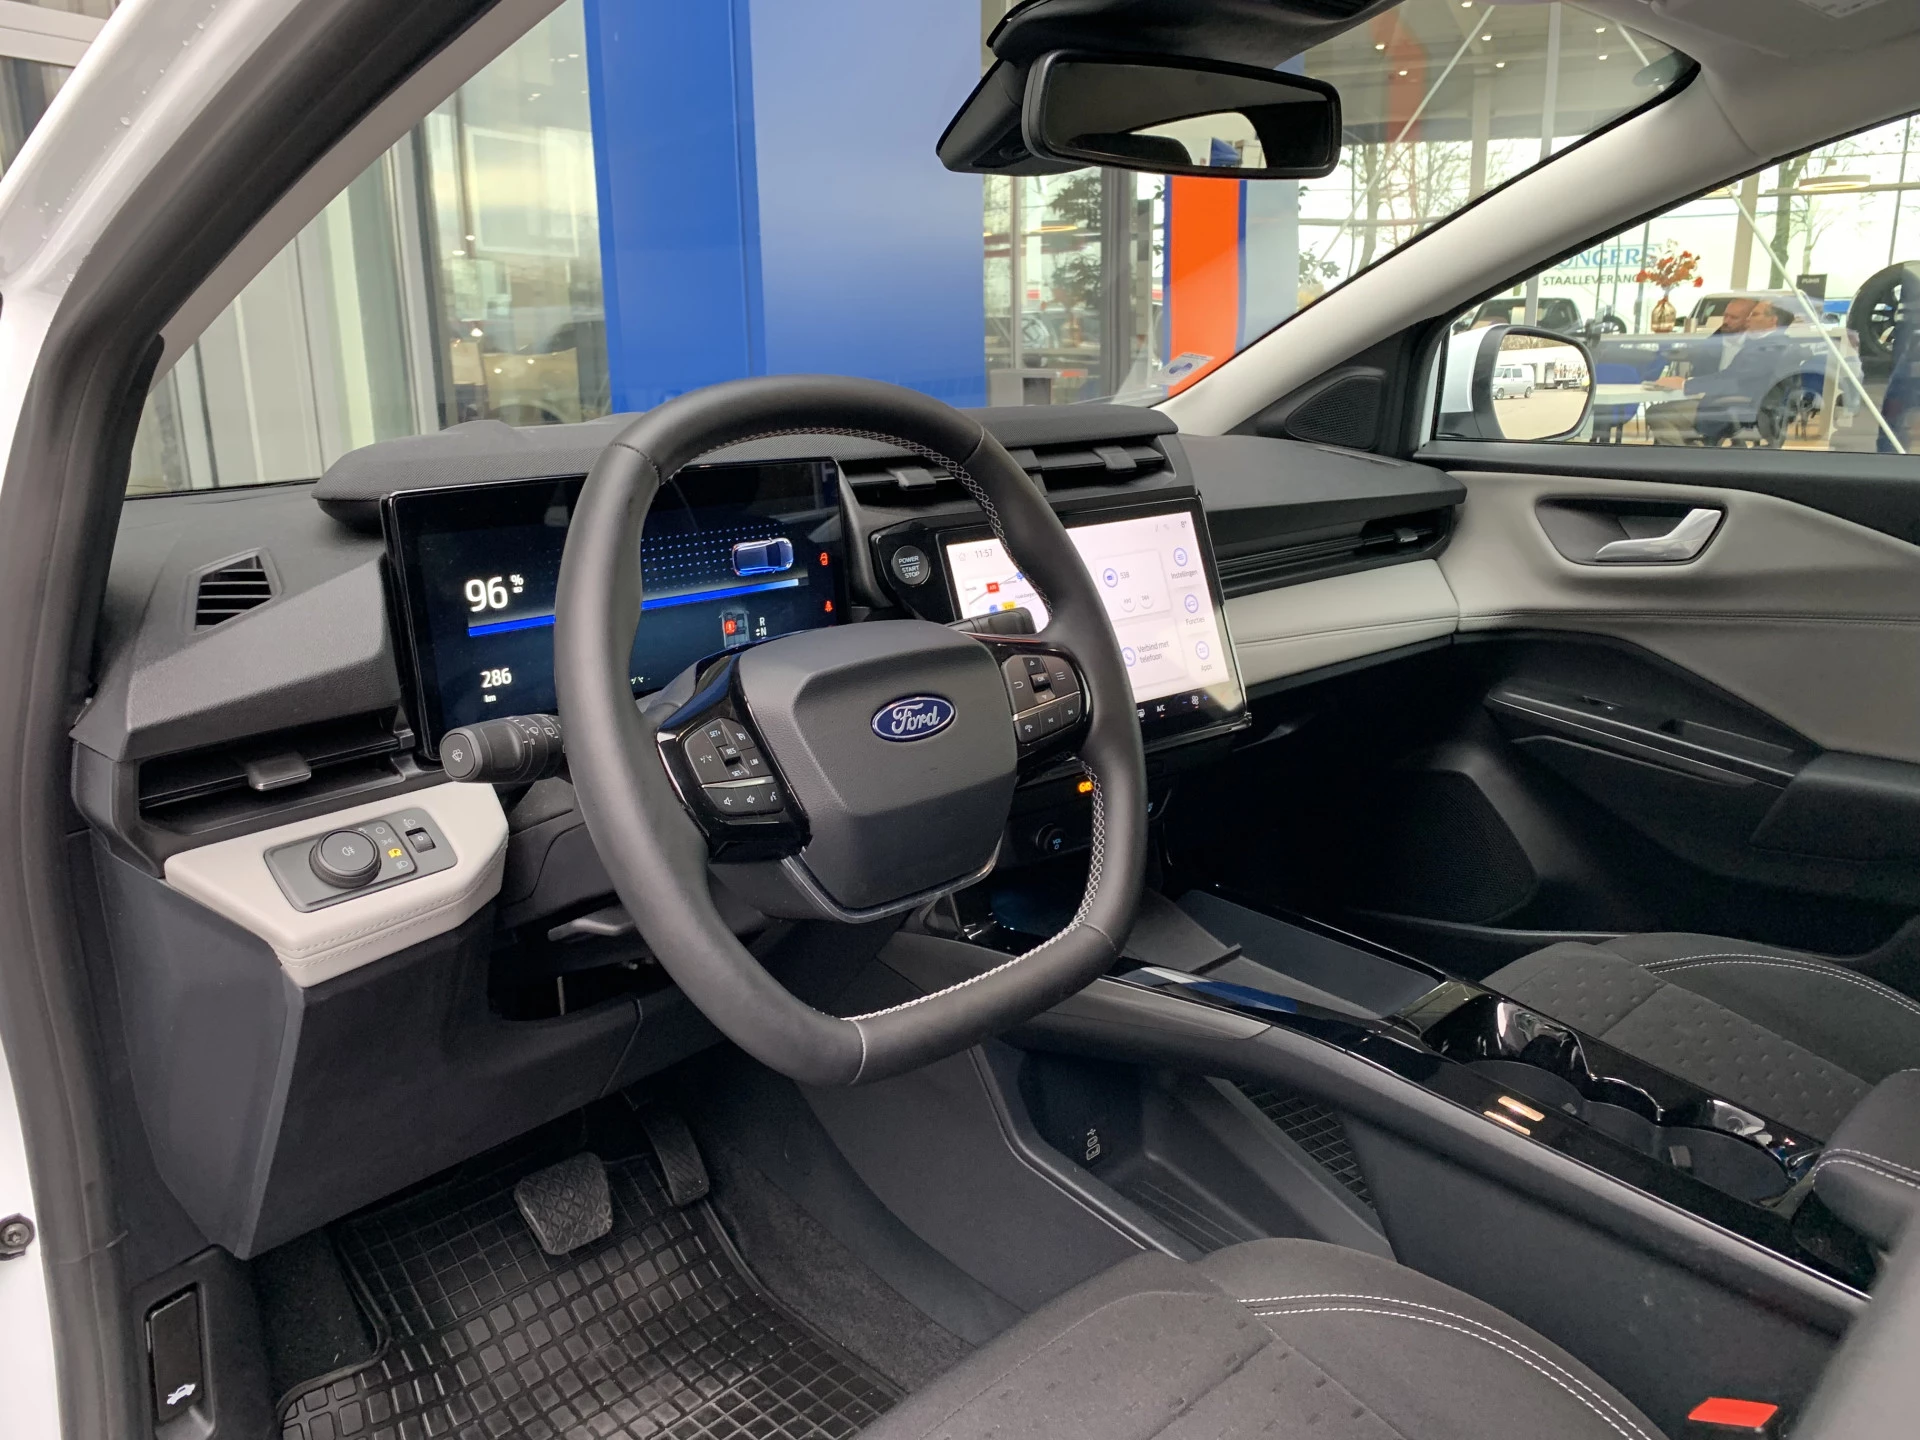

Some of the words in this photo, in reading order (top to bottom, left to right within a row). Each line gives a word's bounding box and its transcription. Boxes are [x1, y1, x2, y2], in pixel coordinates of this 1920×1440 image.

[975, 549, 993, 559] 11:57
[898, 555, 919, 564] POWER
[901, 565, 919, 573] START
[905, 571, 920, 579] STOP
[465, 576, 508, 612] 96
[759, 616, 766, 627] R
[760, 627, 767, 636] N
[480, 668, 512, 689] 286
[483, 694, 497, 703] km
[1156, 704, 1166, 712] A/C
[891, 702, 941, 734] Ford
[725, 747, 737, 755] RES
